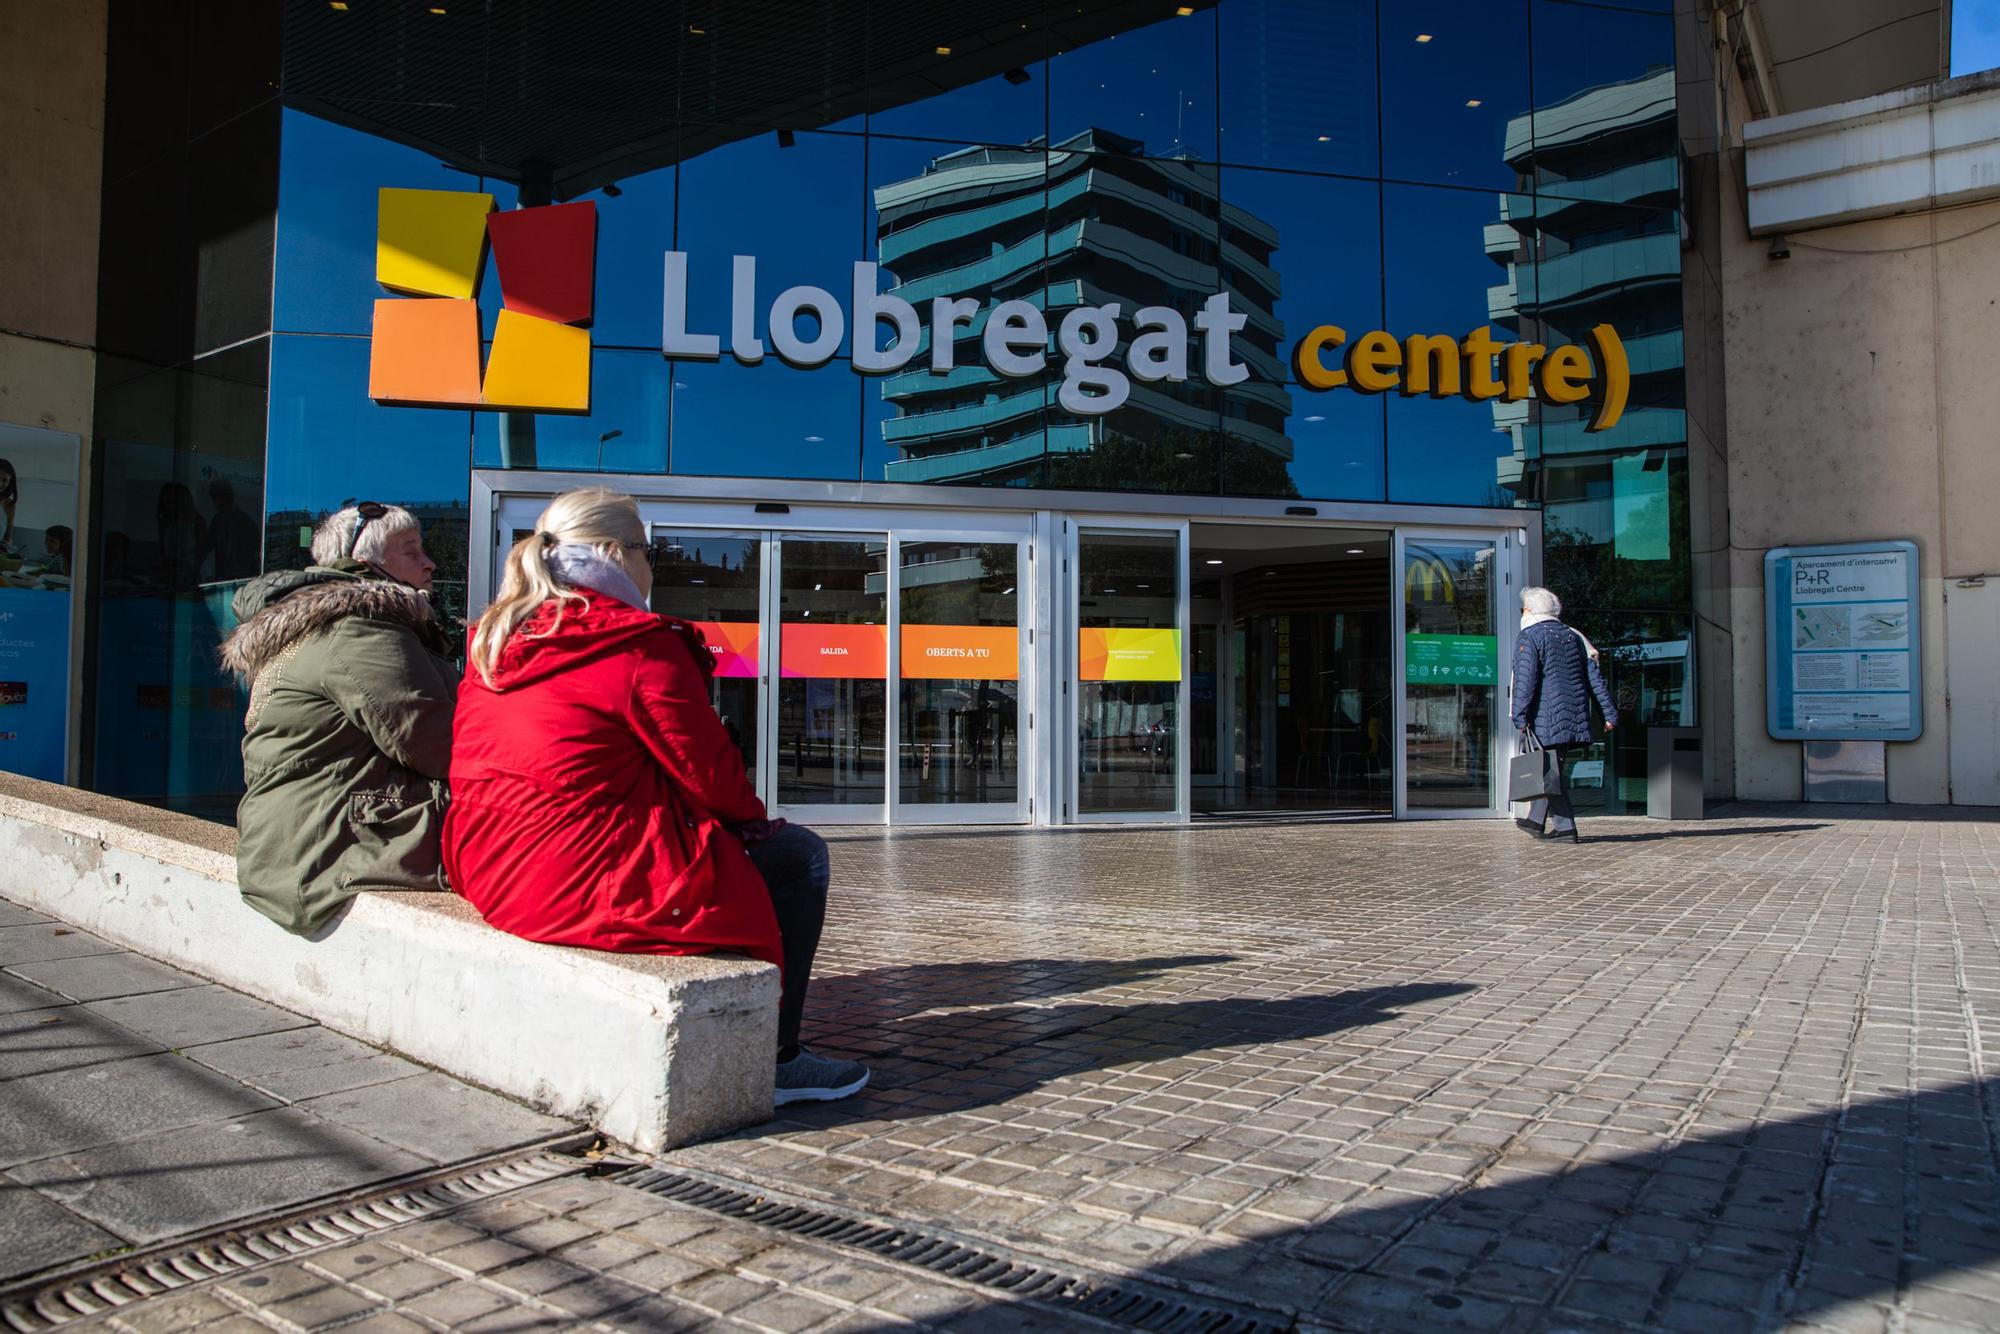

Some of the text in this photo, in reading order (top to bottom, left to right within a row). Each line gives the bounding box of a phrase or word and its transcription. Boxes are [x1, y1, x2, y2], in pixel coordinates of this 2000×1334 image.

[662, 250, 1630, 431] Llobregat centre)
[1796, 560, 1845, 570] Aparcament
[1795, 569, 1830, 586] P+R
[1795, 584, 1865, 595] Llobregat Centre
[820, 647, 849, 656] SALIDA
[926, 647, 990, 658] OBERTS A TU
